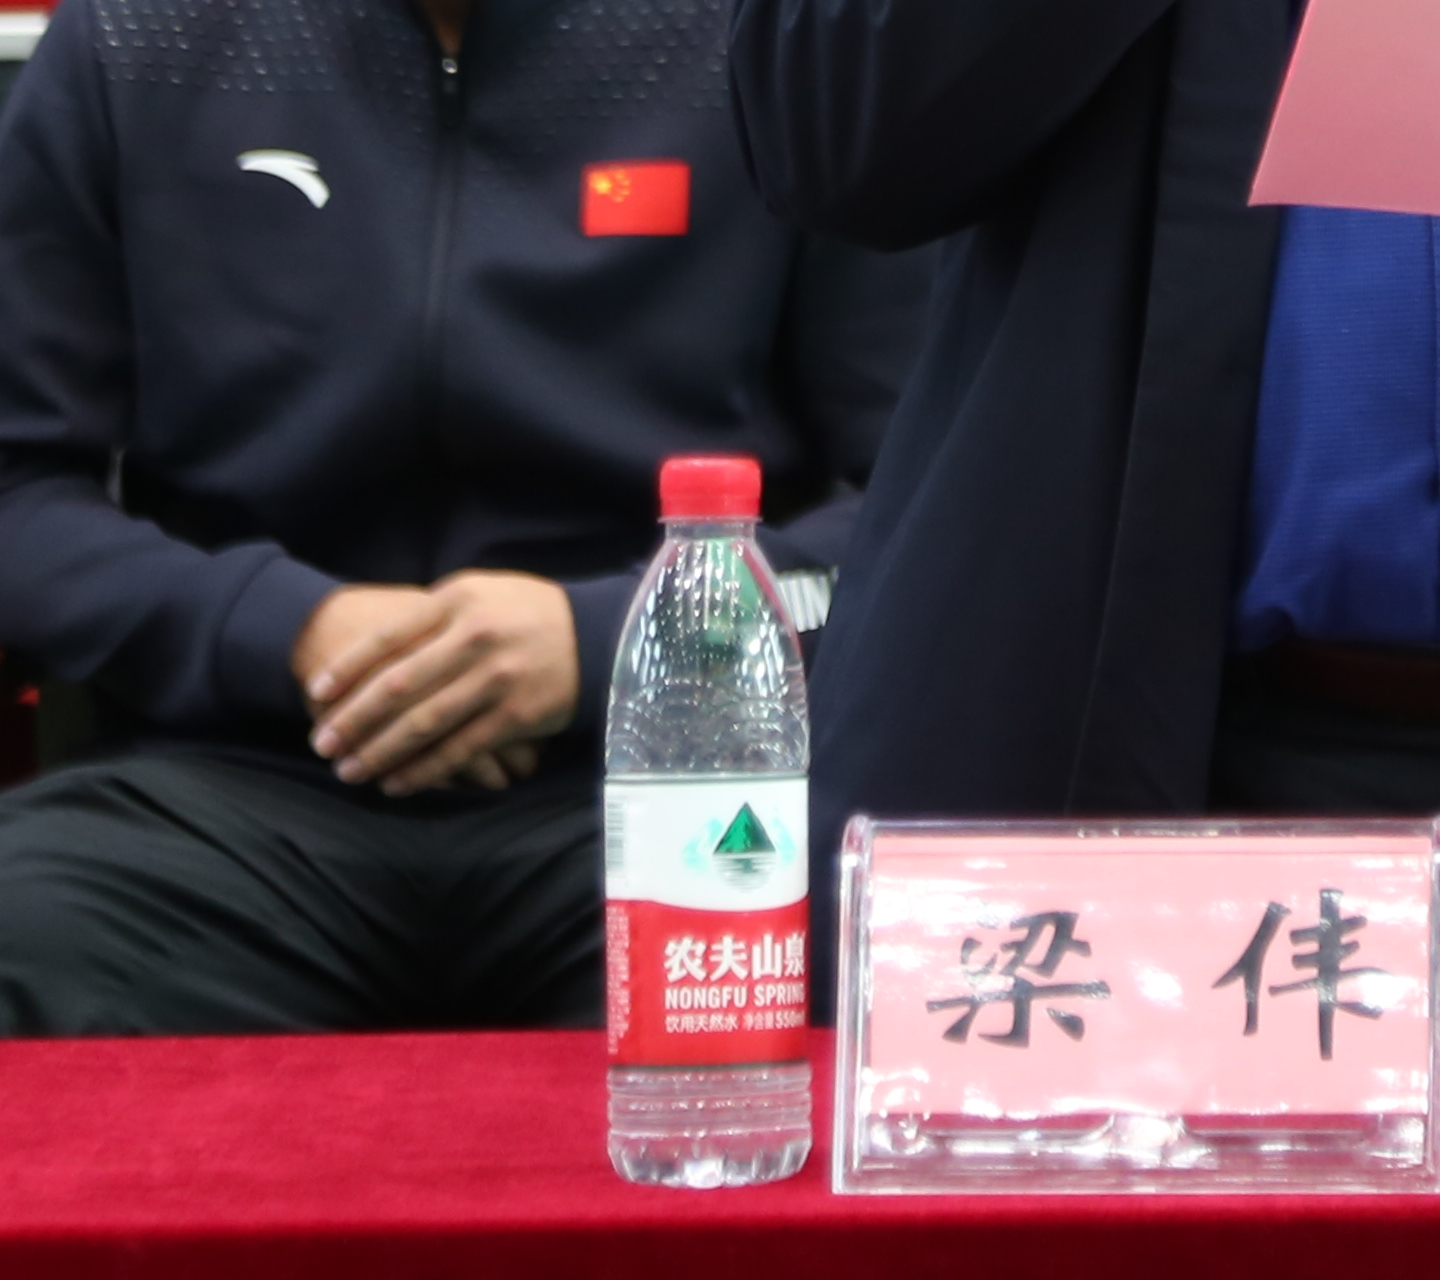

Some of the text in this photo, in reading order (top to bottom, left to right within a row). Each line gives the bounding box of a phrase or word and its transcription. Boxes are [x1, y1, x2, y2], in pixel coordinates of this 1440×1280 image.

[663, 932, 806, 983] 农夫山泉
[926, 888, 1392, 1061] 梁伟
[665, 986, 748, 1010] NONGFU
[665, 1013, 739, 1034] 饮用天然水
